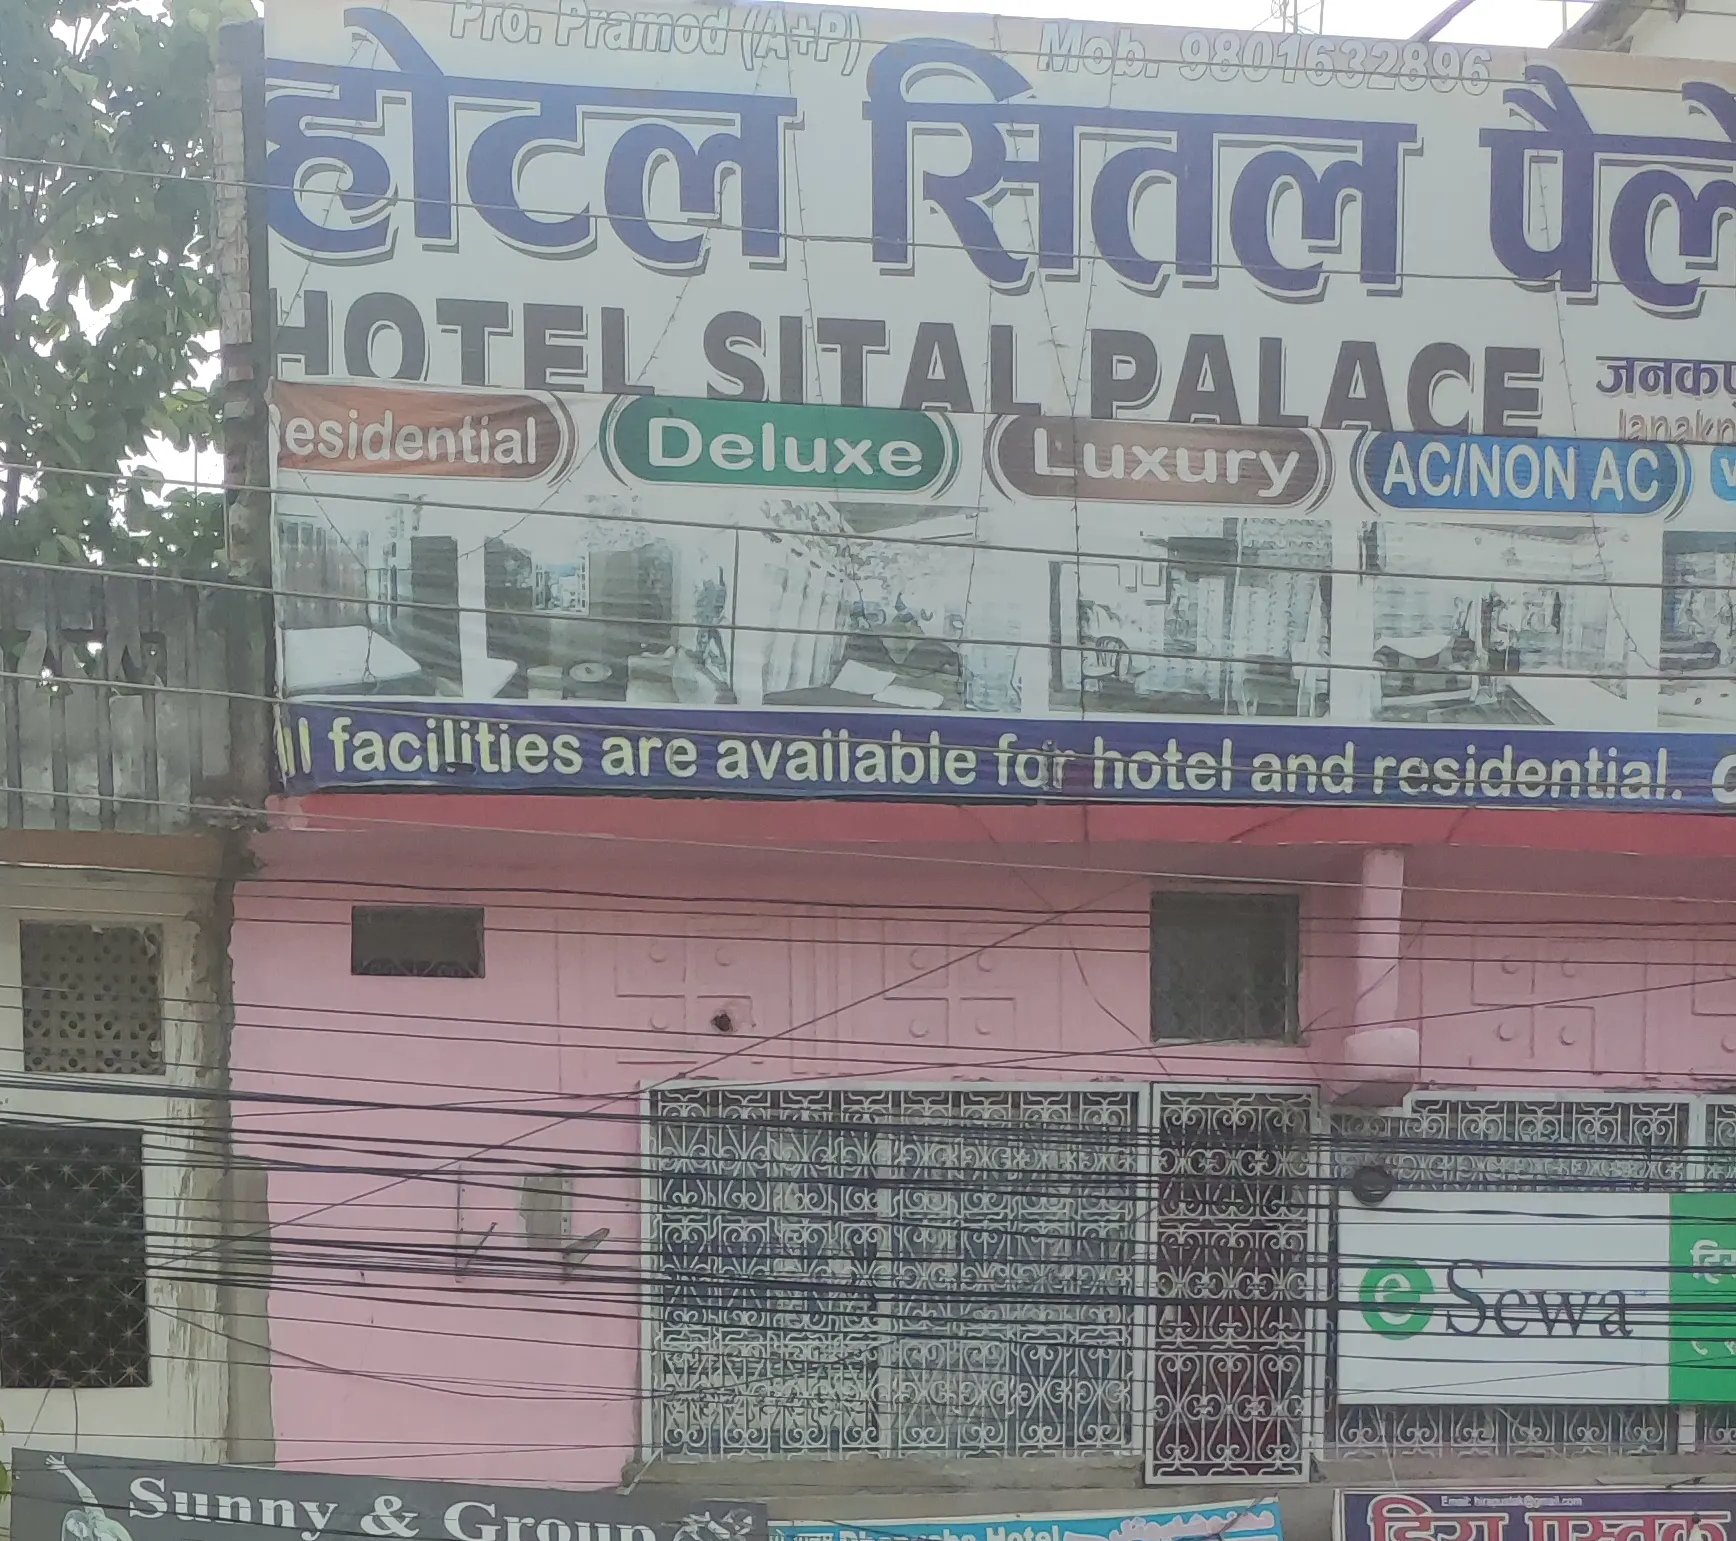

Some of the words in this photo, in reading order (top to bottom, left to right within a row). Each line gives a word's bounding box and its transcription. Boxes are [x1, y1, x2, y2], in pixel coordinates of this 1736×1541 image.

[555, 6, 729, 56] Pramod
[1037, 21, 1160, 79] Mob.
[265, 7, 802, 272] होटल
[862, 37, 1424, 302] सितल
[269, 286, 655, 397] HOTEL
[703, 311, 1042, 416] SITAL
[1090, 328, 1546, 437] PALACE
[270, 405, 537, 467] esidential
[647, 418, 924, 477] Deluxe
[1032, 427, 1301, 500] Luxury
[1382, 440, 1576, 502] AC/NON
[1591, 446, 1659, 502] AC
[328, 714, 586, 776] facilities
[602, 734, 699, 778] are
[716, 726, 978, 787] available
[994, 732, 1074, 791] for
[1093, 735, 1233, 792] hotel
[1250, 740, 1355, 796] and
[360, 1494, 421, 1541] &
